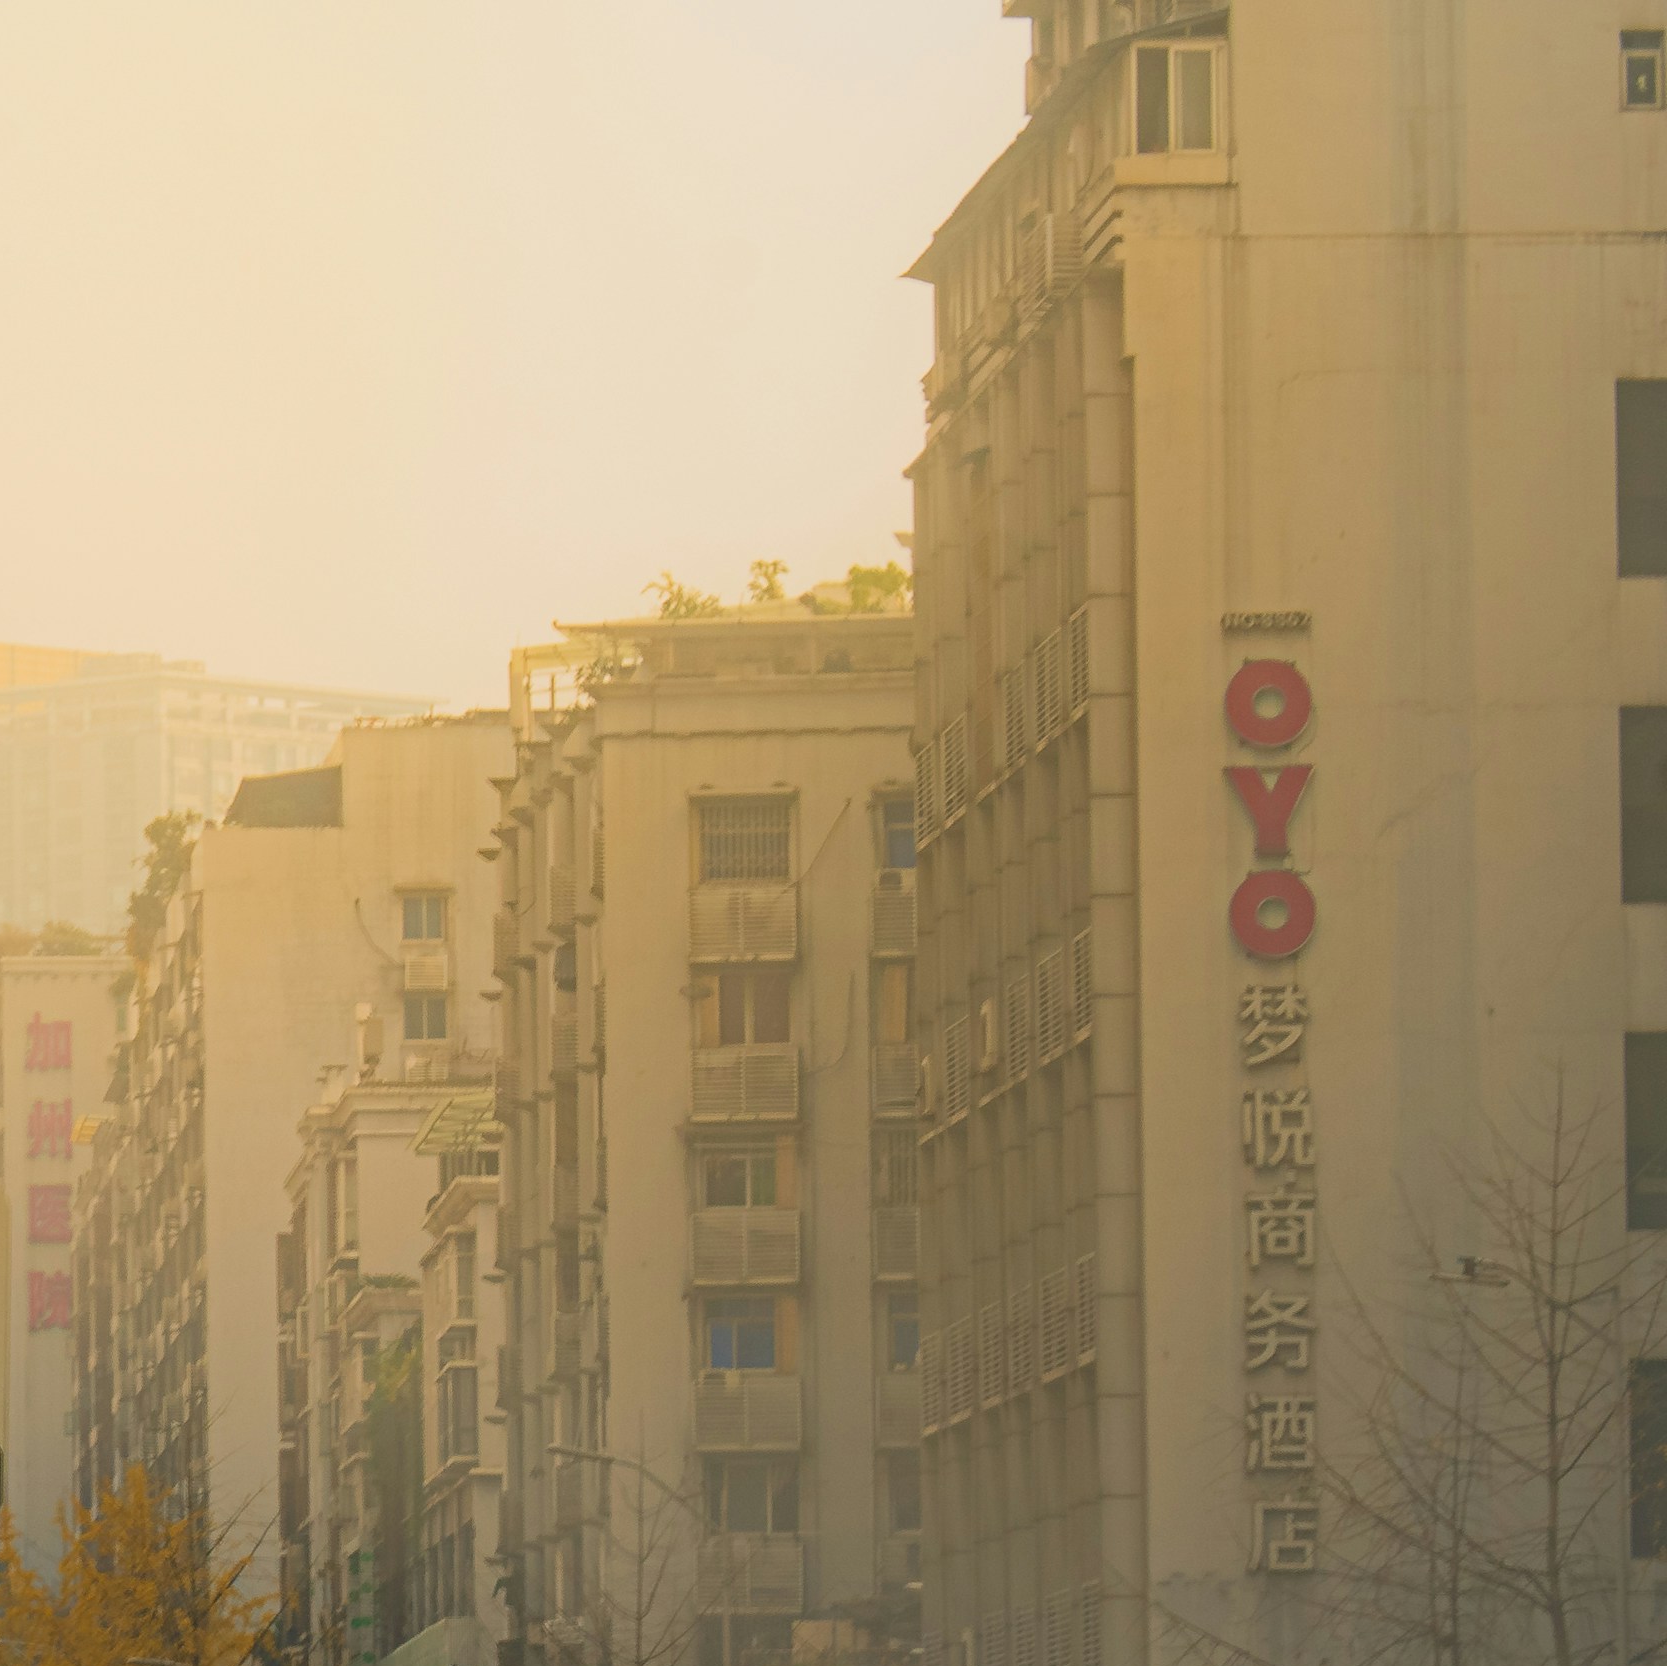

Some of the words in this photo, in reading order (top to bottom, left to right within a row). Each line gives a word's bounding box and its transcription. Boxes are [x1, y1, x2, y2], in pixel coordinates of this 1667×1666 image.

[1223, 657, 1317, 958] OYO
[1237, 982, 1318, 1574] 梦悦商务酒店
